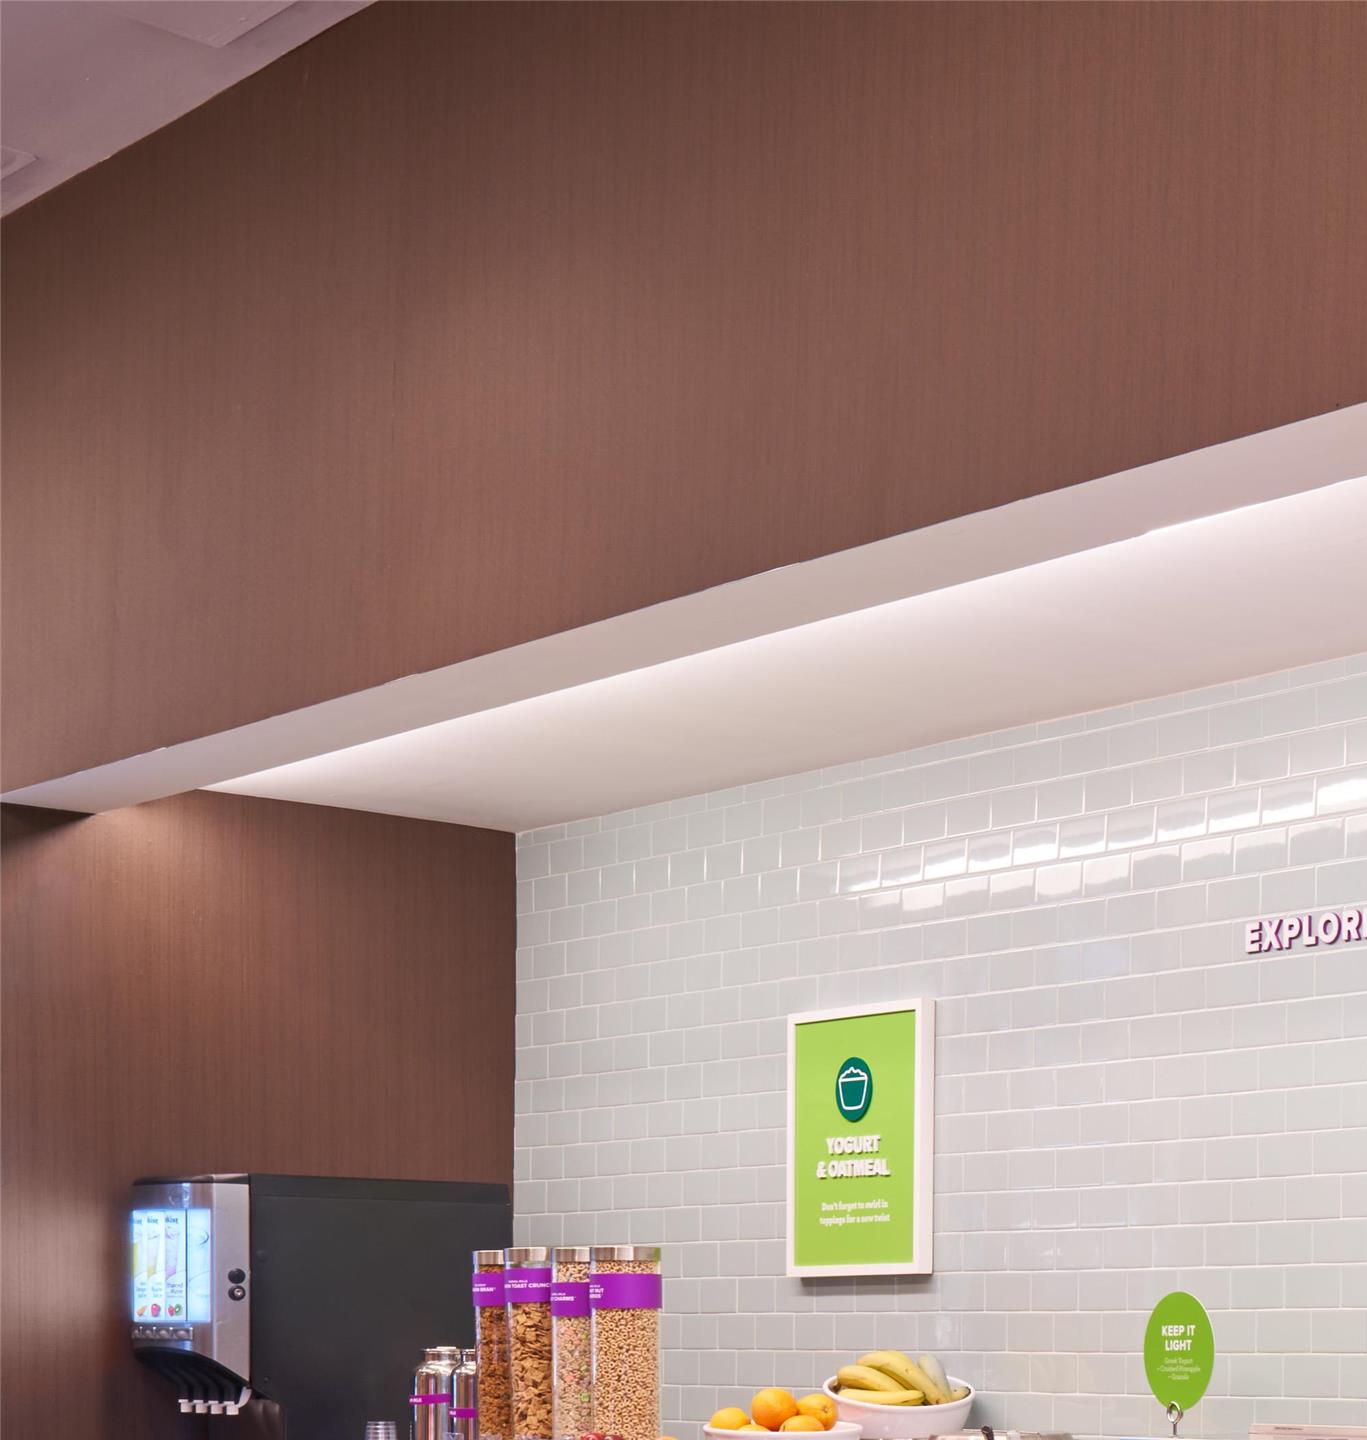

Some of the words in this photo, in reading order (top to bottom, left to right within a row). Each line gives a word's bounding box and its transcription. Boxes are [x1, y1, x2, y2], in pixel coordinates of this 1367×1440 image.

[826, 1135, 881, 1155] YOGURT
[816, 1161, 827, 1179] &
[828, 1158, 892, 1179] OATMEAL
[1161, 1324, 1185, 1337] KEEP
[1187, 1324, 1196, 1337] IT
[1165, 1339, 1192, 1351] LIGHT
